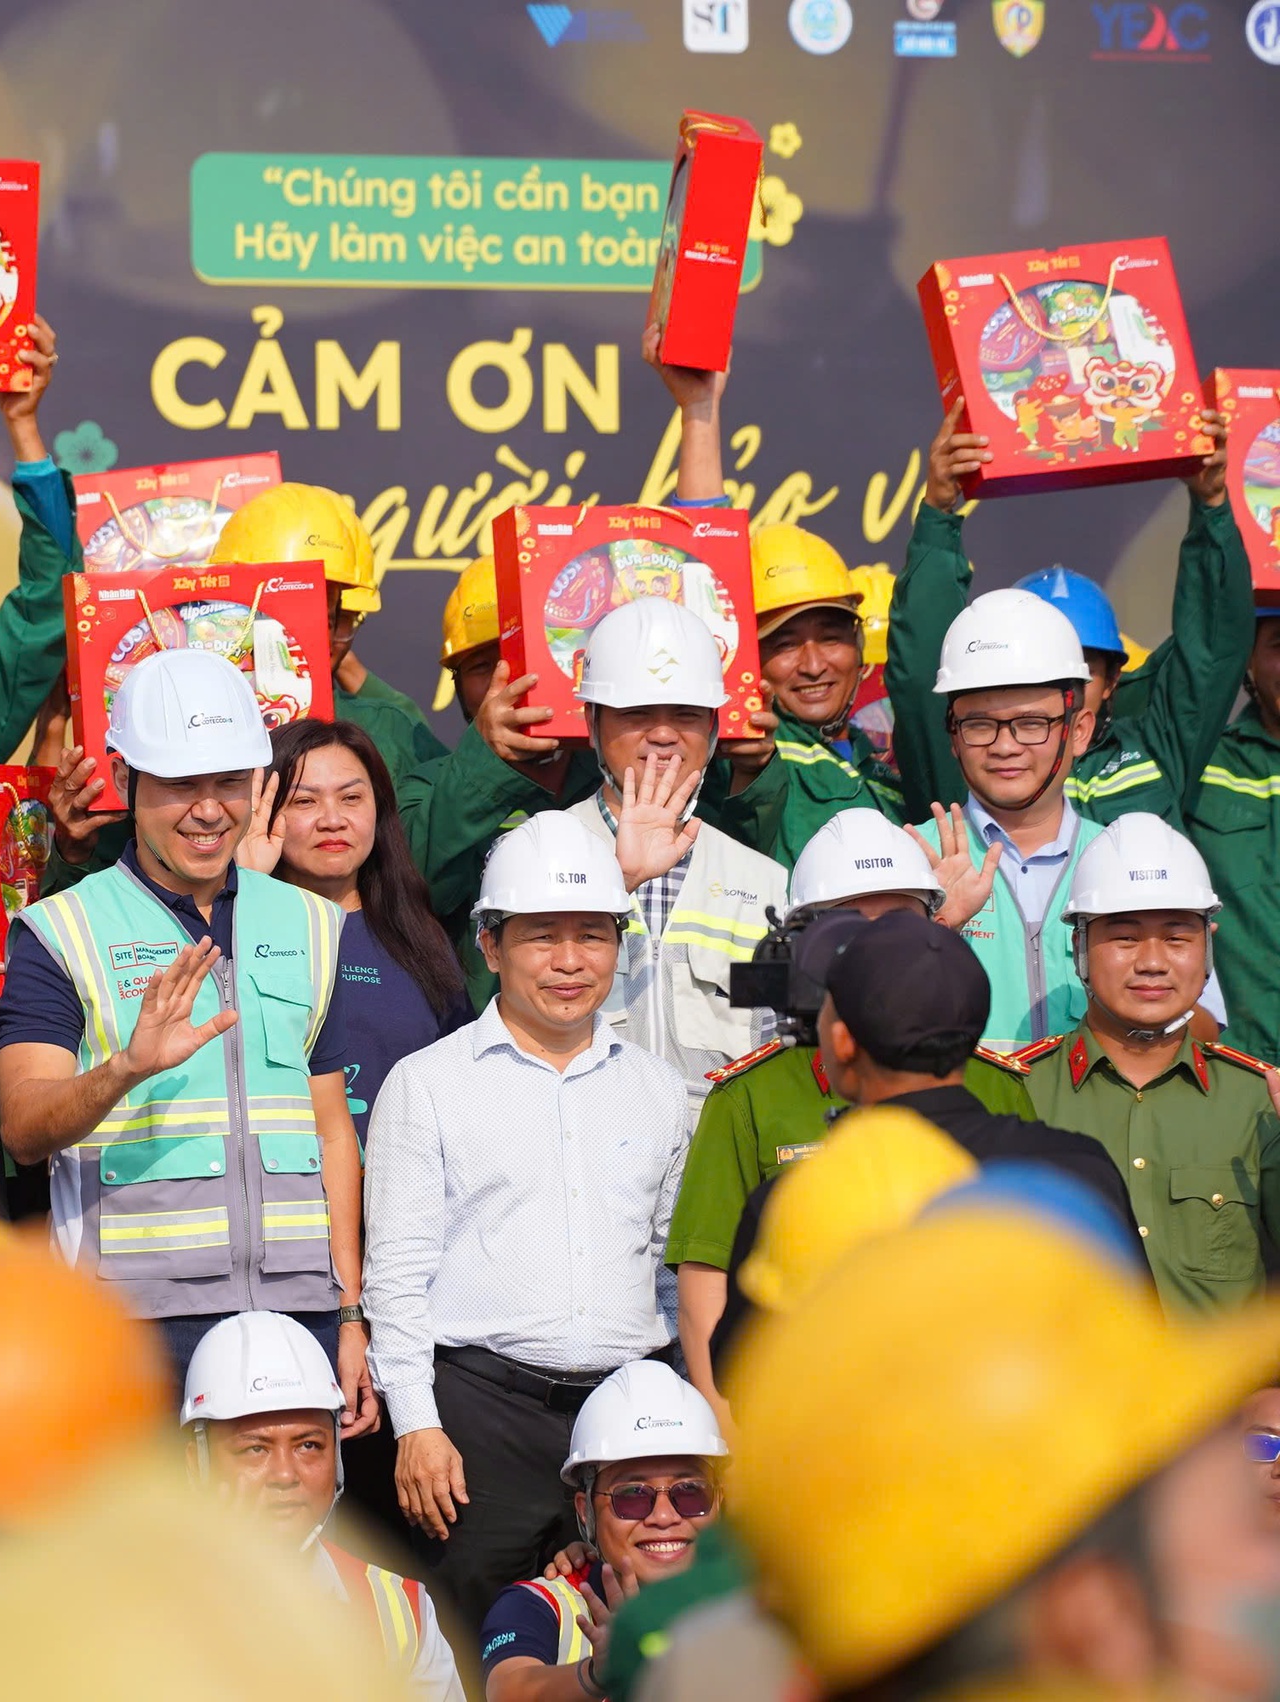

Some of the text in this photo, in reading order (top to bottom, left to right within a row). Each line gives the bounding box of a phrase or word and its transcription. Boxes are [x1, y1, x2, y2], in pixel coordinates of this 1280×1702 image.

[262, 164, 659, 221] “Chúng tôi cần bạn
[235, 221, 319, 271] Hãy
[330, 222, 406, 262] làm
[419, 224, 502, 272] việc
[513, 235, 565, 265] an
[150, 305, 619, 434] CẢM ƠN
[173, 575, 217, 591] Xây Tết
[854, 857, 894, 870] VISITOR
[548, 873, 587, 884] ISTOR
[1129, 869, 1167, 881] VISITOR
[724, 889, 757, 900] SONKIM
[960, 930, 995, 939] ITMENT
[115, 951, 132, 961] SITE
[135, 947, 177, 955] MANAGEMENT
[269, 949, 305, 957] COTECCOS
[124, 979, 131, 987] &
